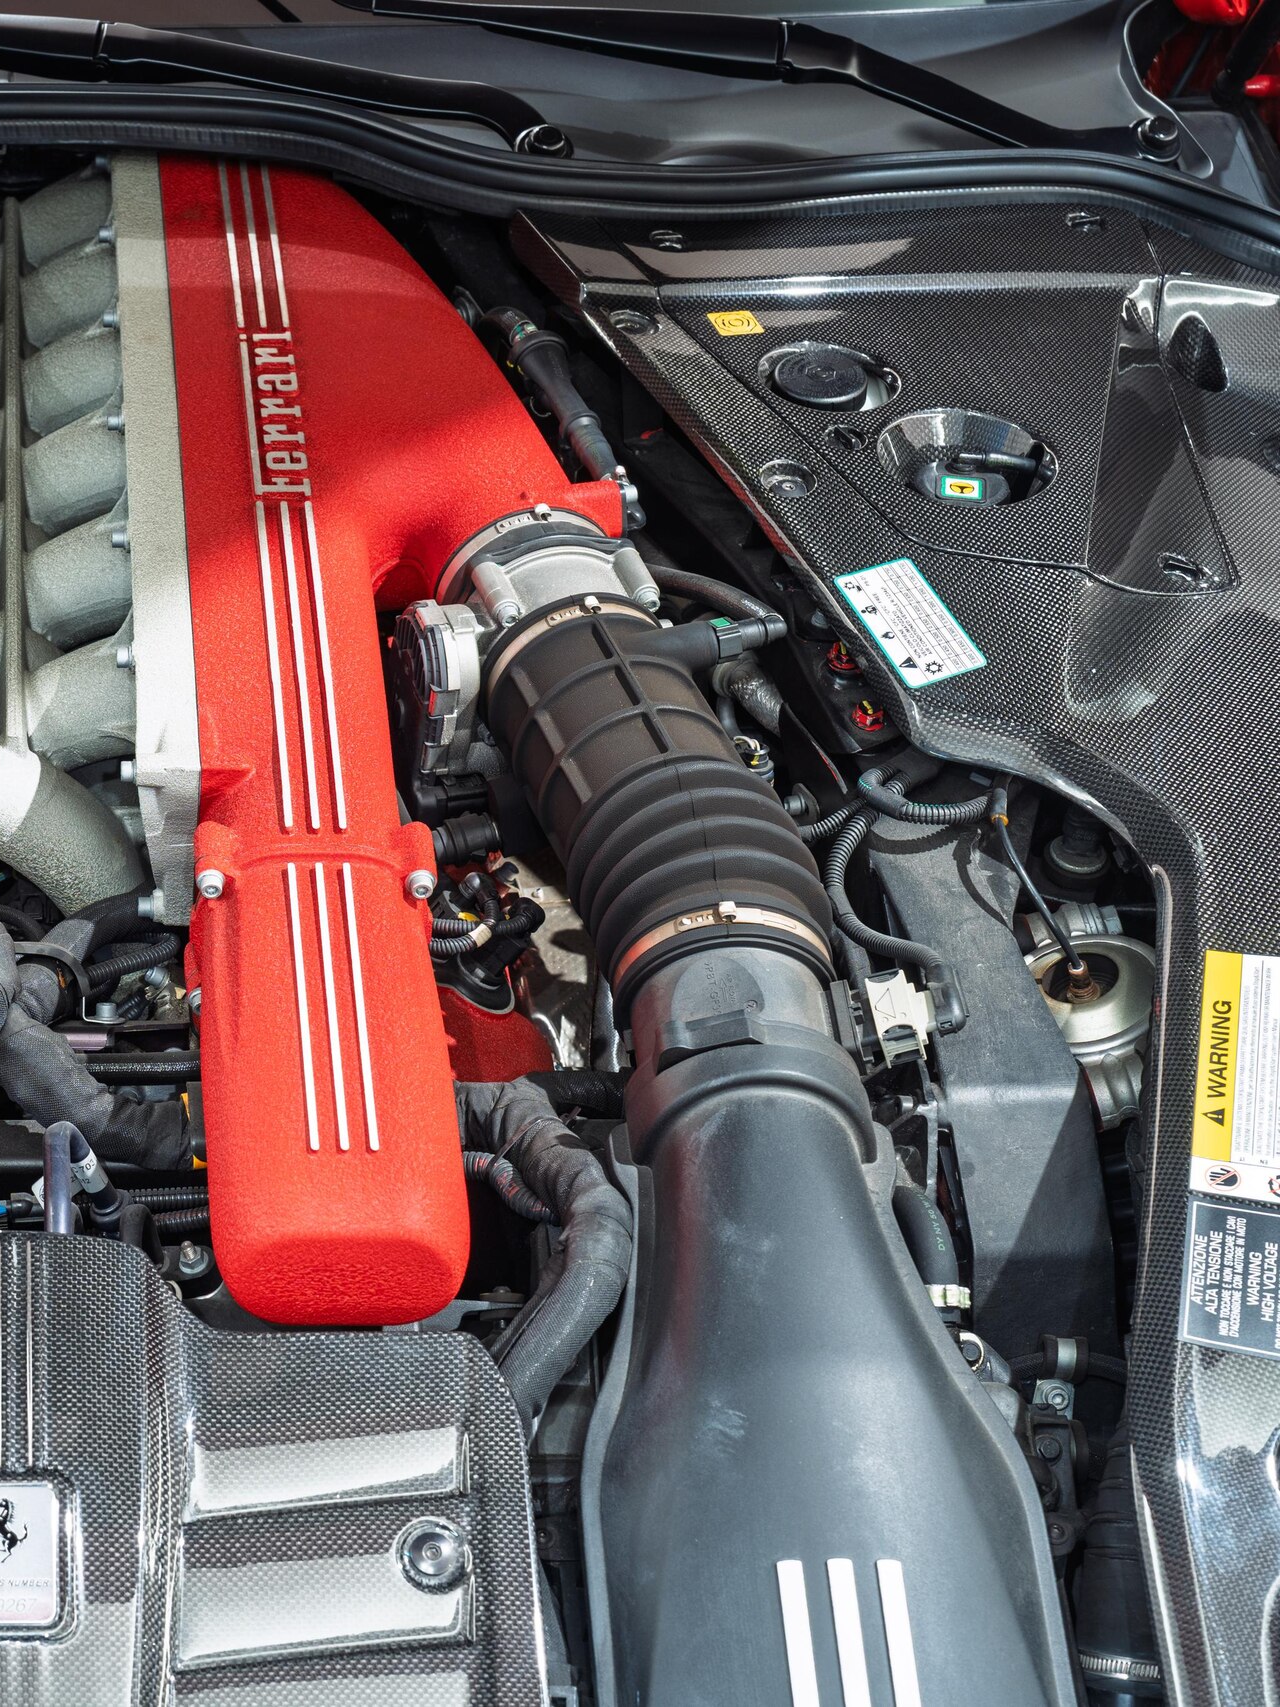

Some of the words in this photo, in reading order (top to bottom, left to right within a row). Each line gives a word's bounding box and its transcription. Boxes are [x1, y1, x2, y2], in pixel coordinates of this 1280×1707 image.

[239, 331, 312, 497] Ferrari
[1207, 1000, 1232, 1098] WARNING
[1227, 1216, 1236, 1229] CAVI
[1236, 1218, 1246, 1236] MOTO
[1207, 1231, 1222, 1286] TENSIONE
[1225, 1235, 1234, 1266] STACCARE
[1234, 1246, 1244, 1273] MOTORE
[1191, 1235, 1207, 1304] ATTENZIONE
[1223, 1267, 1232, 1282] NON
[1247, 1251, 1261, 1307] WARNING
[1263, 1242, 1277, 1291] VOLTAGE
[1233, 1274, 1242, 1289] CON
[1205, 1287, 1218, 1314] ALTA
[1221, 1289, 1231, 1318] TOCCARE
[1230, 1290, 1241, 1337] D'ACCENSIONE
[1261, 1292, 1275, 1322] HIGH
[1219, 1320, 1228, 1336] NON
[8, 1579, 50, 1587] NUMBER
